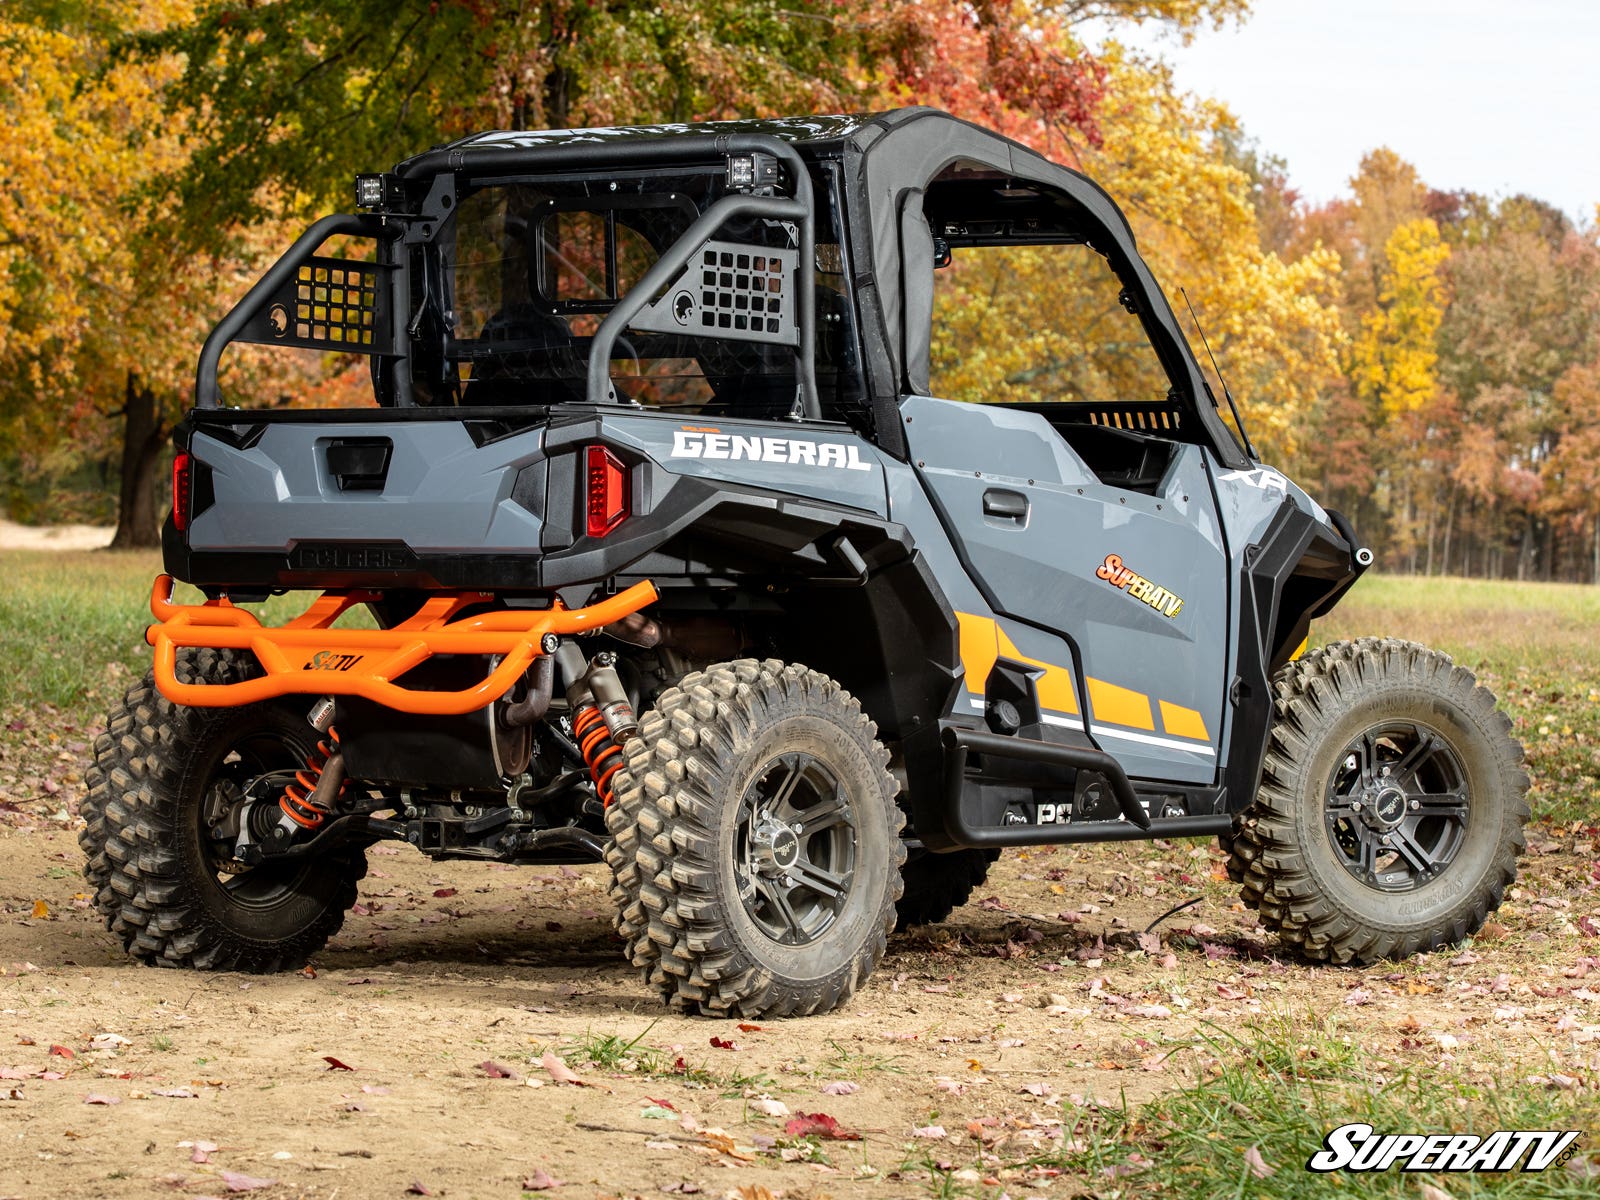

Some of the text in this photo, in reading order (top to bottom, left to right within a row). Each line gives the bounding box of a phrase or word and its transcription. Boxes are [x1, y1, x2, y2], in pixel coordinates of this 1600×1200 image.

[671, 431, 872, 471] GENERAL
[300, 549, 406, 567] POLARIS
[1095, 553, 1183, 618] SUPERATV
